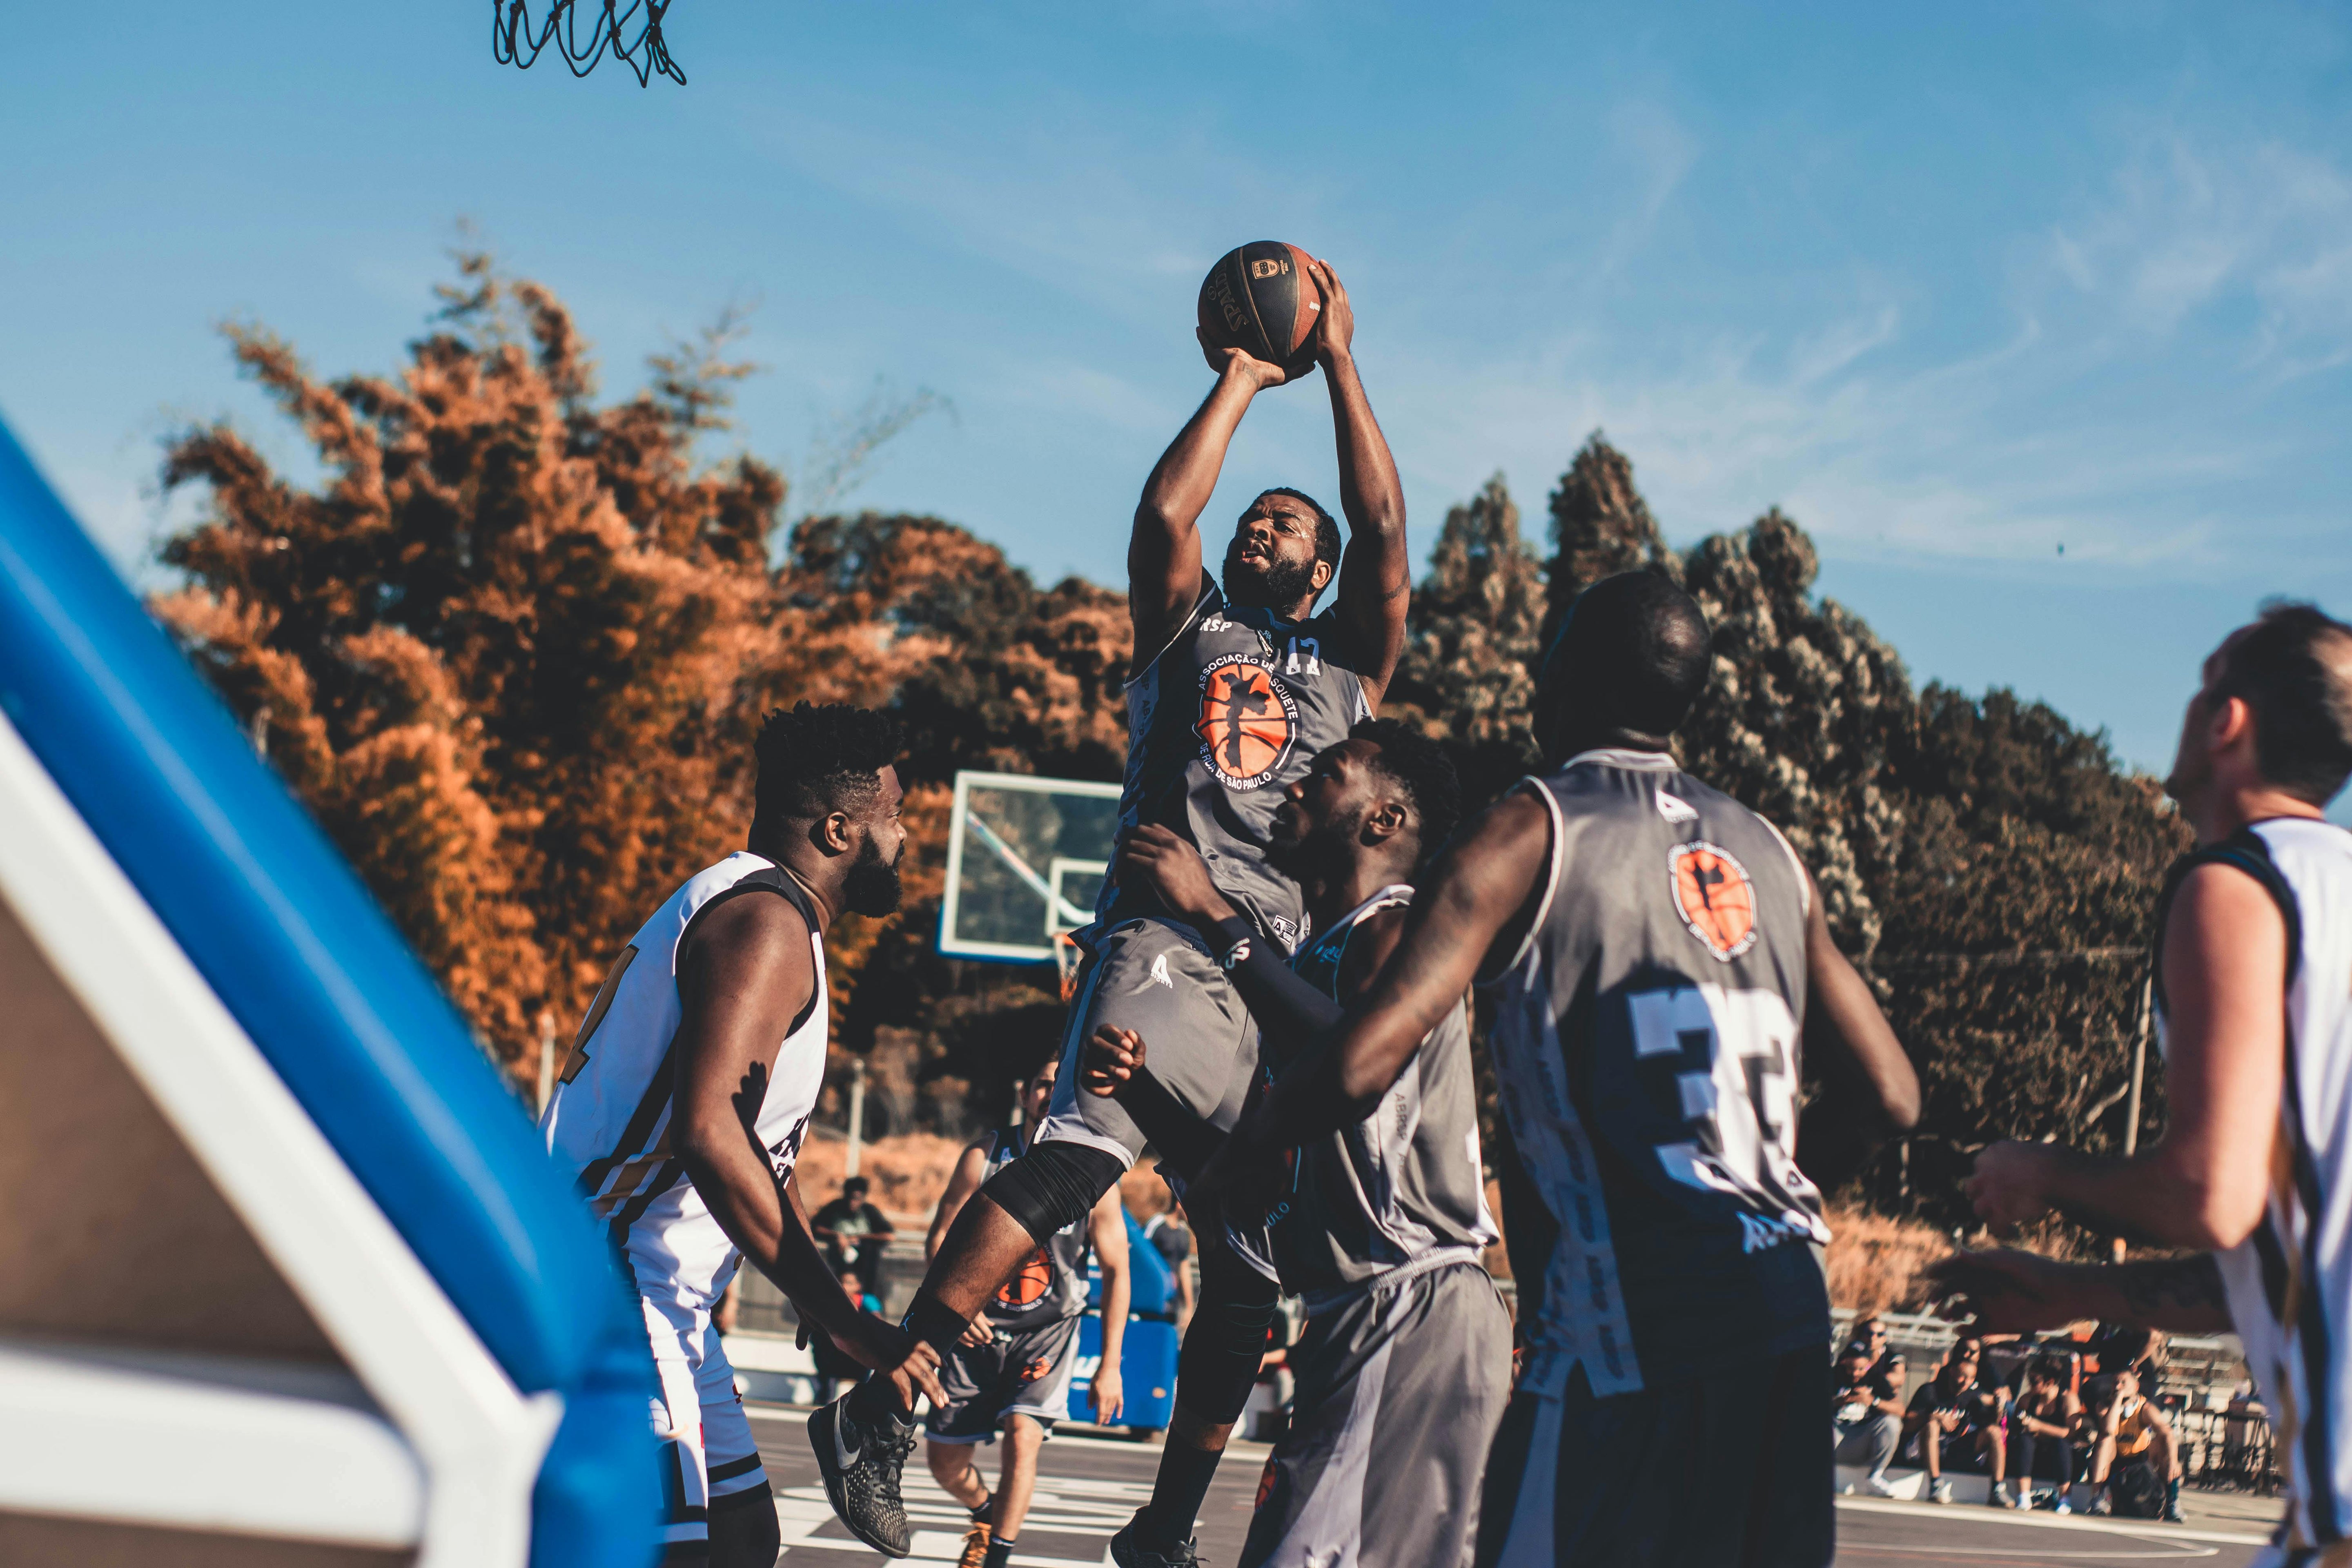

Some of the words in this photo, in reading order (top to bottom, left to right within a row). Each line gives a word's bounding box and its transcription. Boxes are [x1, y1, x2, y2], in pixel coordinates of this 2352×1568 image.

[1286, 637, 1321, 676] 17
[1198, 653, 1258, 690] ASSOCIAÇÃO
[1261, 661, 1275, 674] DE
[1269, 674, 1298, 719] SQUETE
[1200, 742, 1209, 755] DE
[1202, 753, 1216, 773] RUA
[1215, 767, 1226, 783] DE
[1227, 776, 1242, 790] SÃO
[1243, 771, 1272, 790] PAULO
[1021, 1298, 1043, 1311] PAULO
